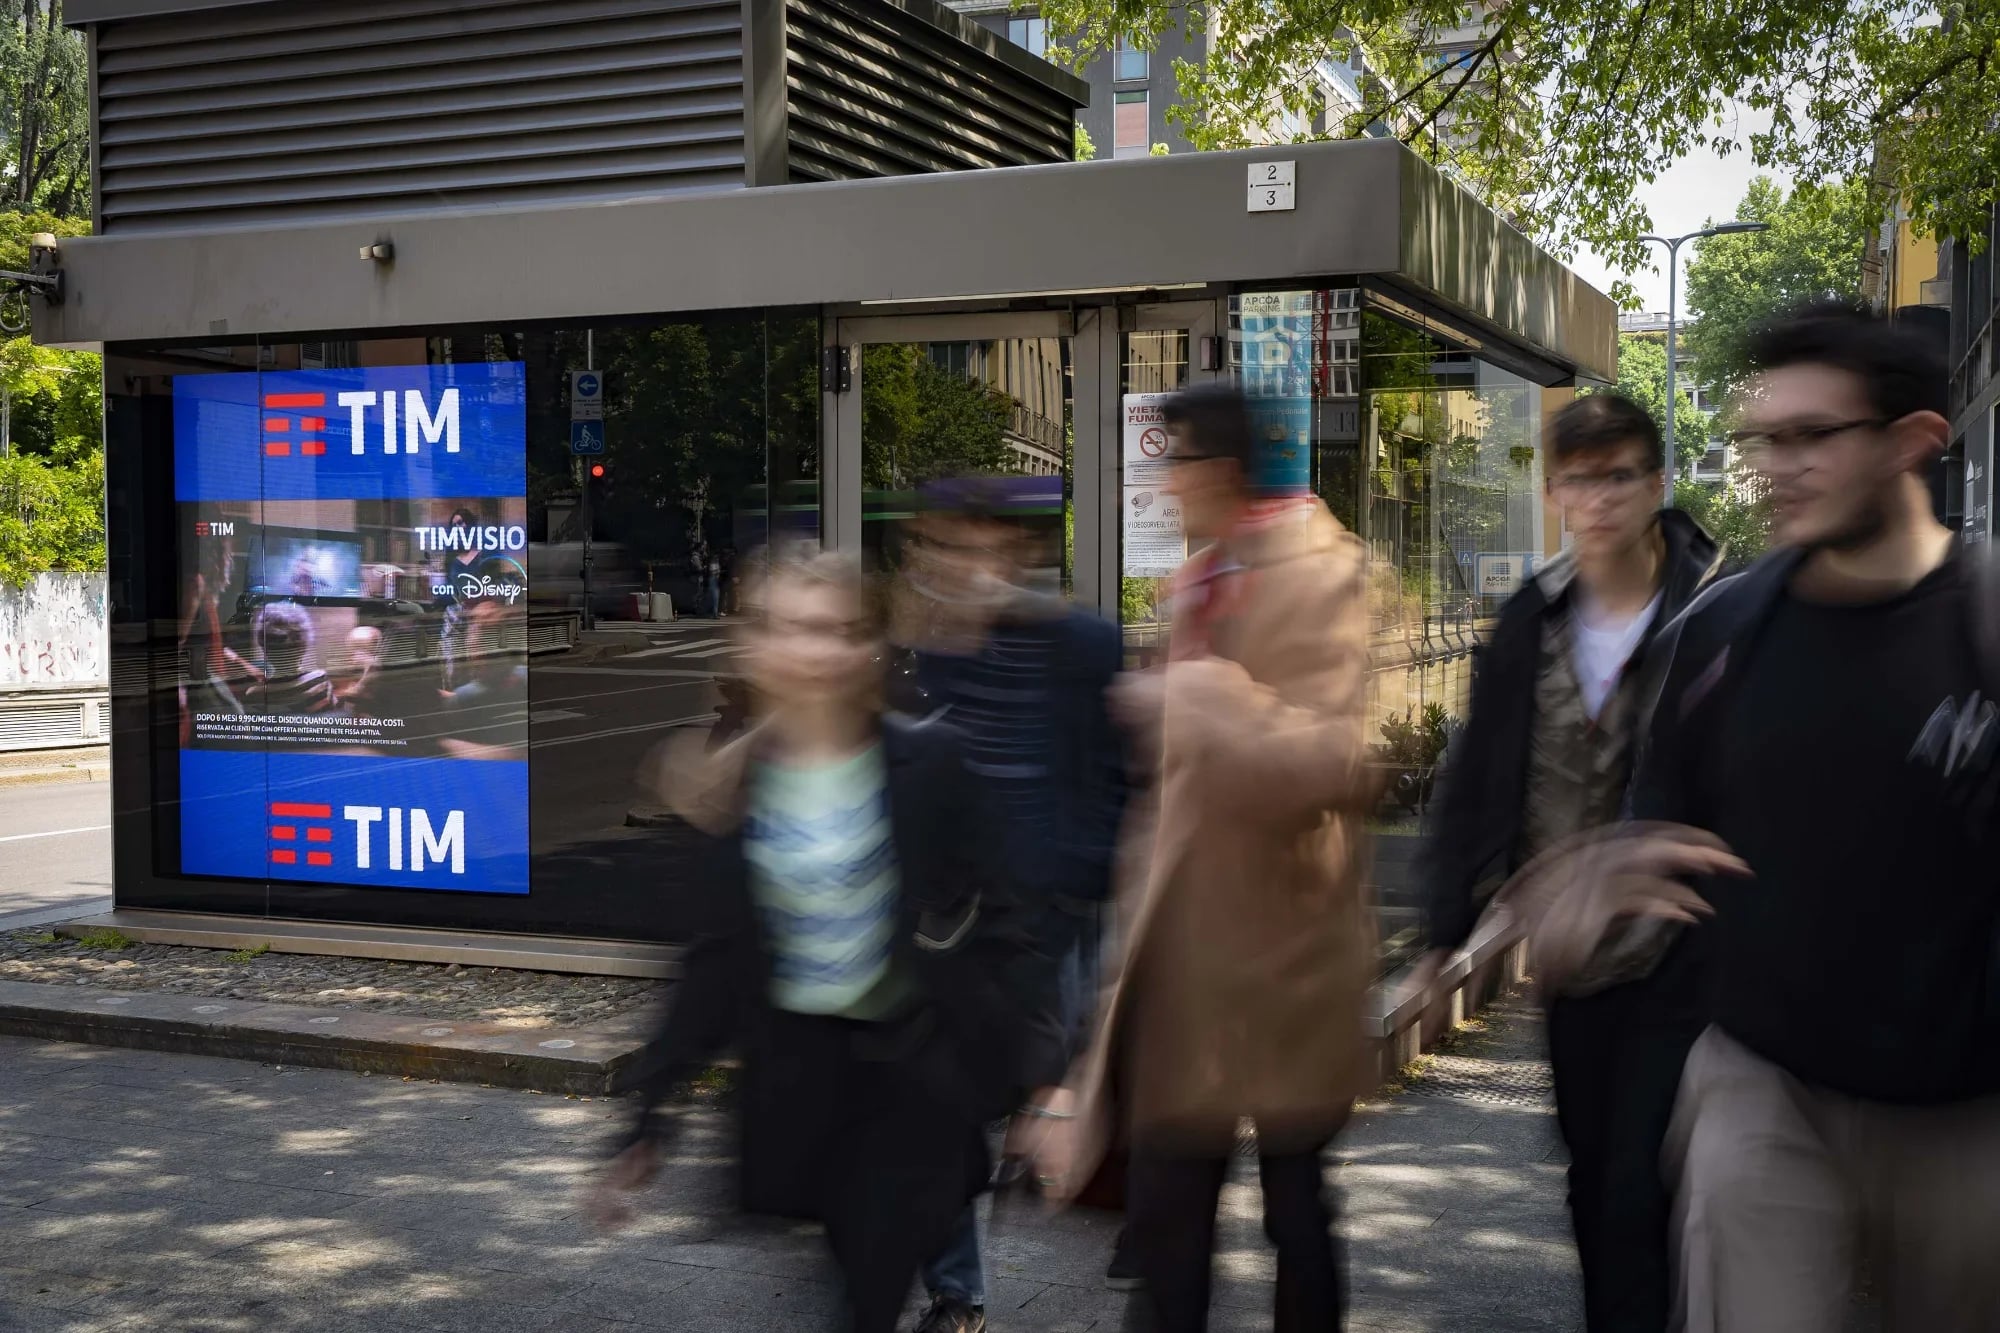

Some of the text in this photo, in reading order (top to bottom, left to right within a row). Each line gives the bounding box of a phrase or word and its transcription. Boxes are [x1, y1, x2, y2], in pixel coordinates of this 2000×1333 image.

[1267, 165, 1277, 180] 2
[1266, 190, 1276, 206] 3
[1244, 295, 1280, 305] APCOA
[1244, 305, 1280, 313] PARKING
[1128, 406, 1165, 414] VIETA
[338, 388, 460, 455] TIM
[1128, 415, 1164, 423] FUMA
[210, 522, 234, 536] TIM
[415, 526, 526, 551] TIMVISIO
[432, 584, 455, 596] con
[196, 713, 216, 721] DOPO
[221, 714, 237, 722] MESI
[303, 716, 334, 725] QUANDO
[335, 717, 352, 725] VUOI
[359, 718, 382, 726] SENZA
[344, 805, 465, 874] TIM
